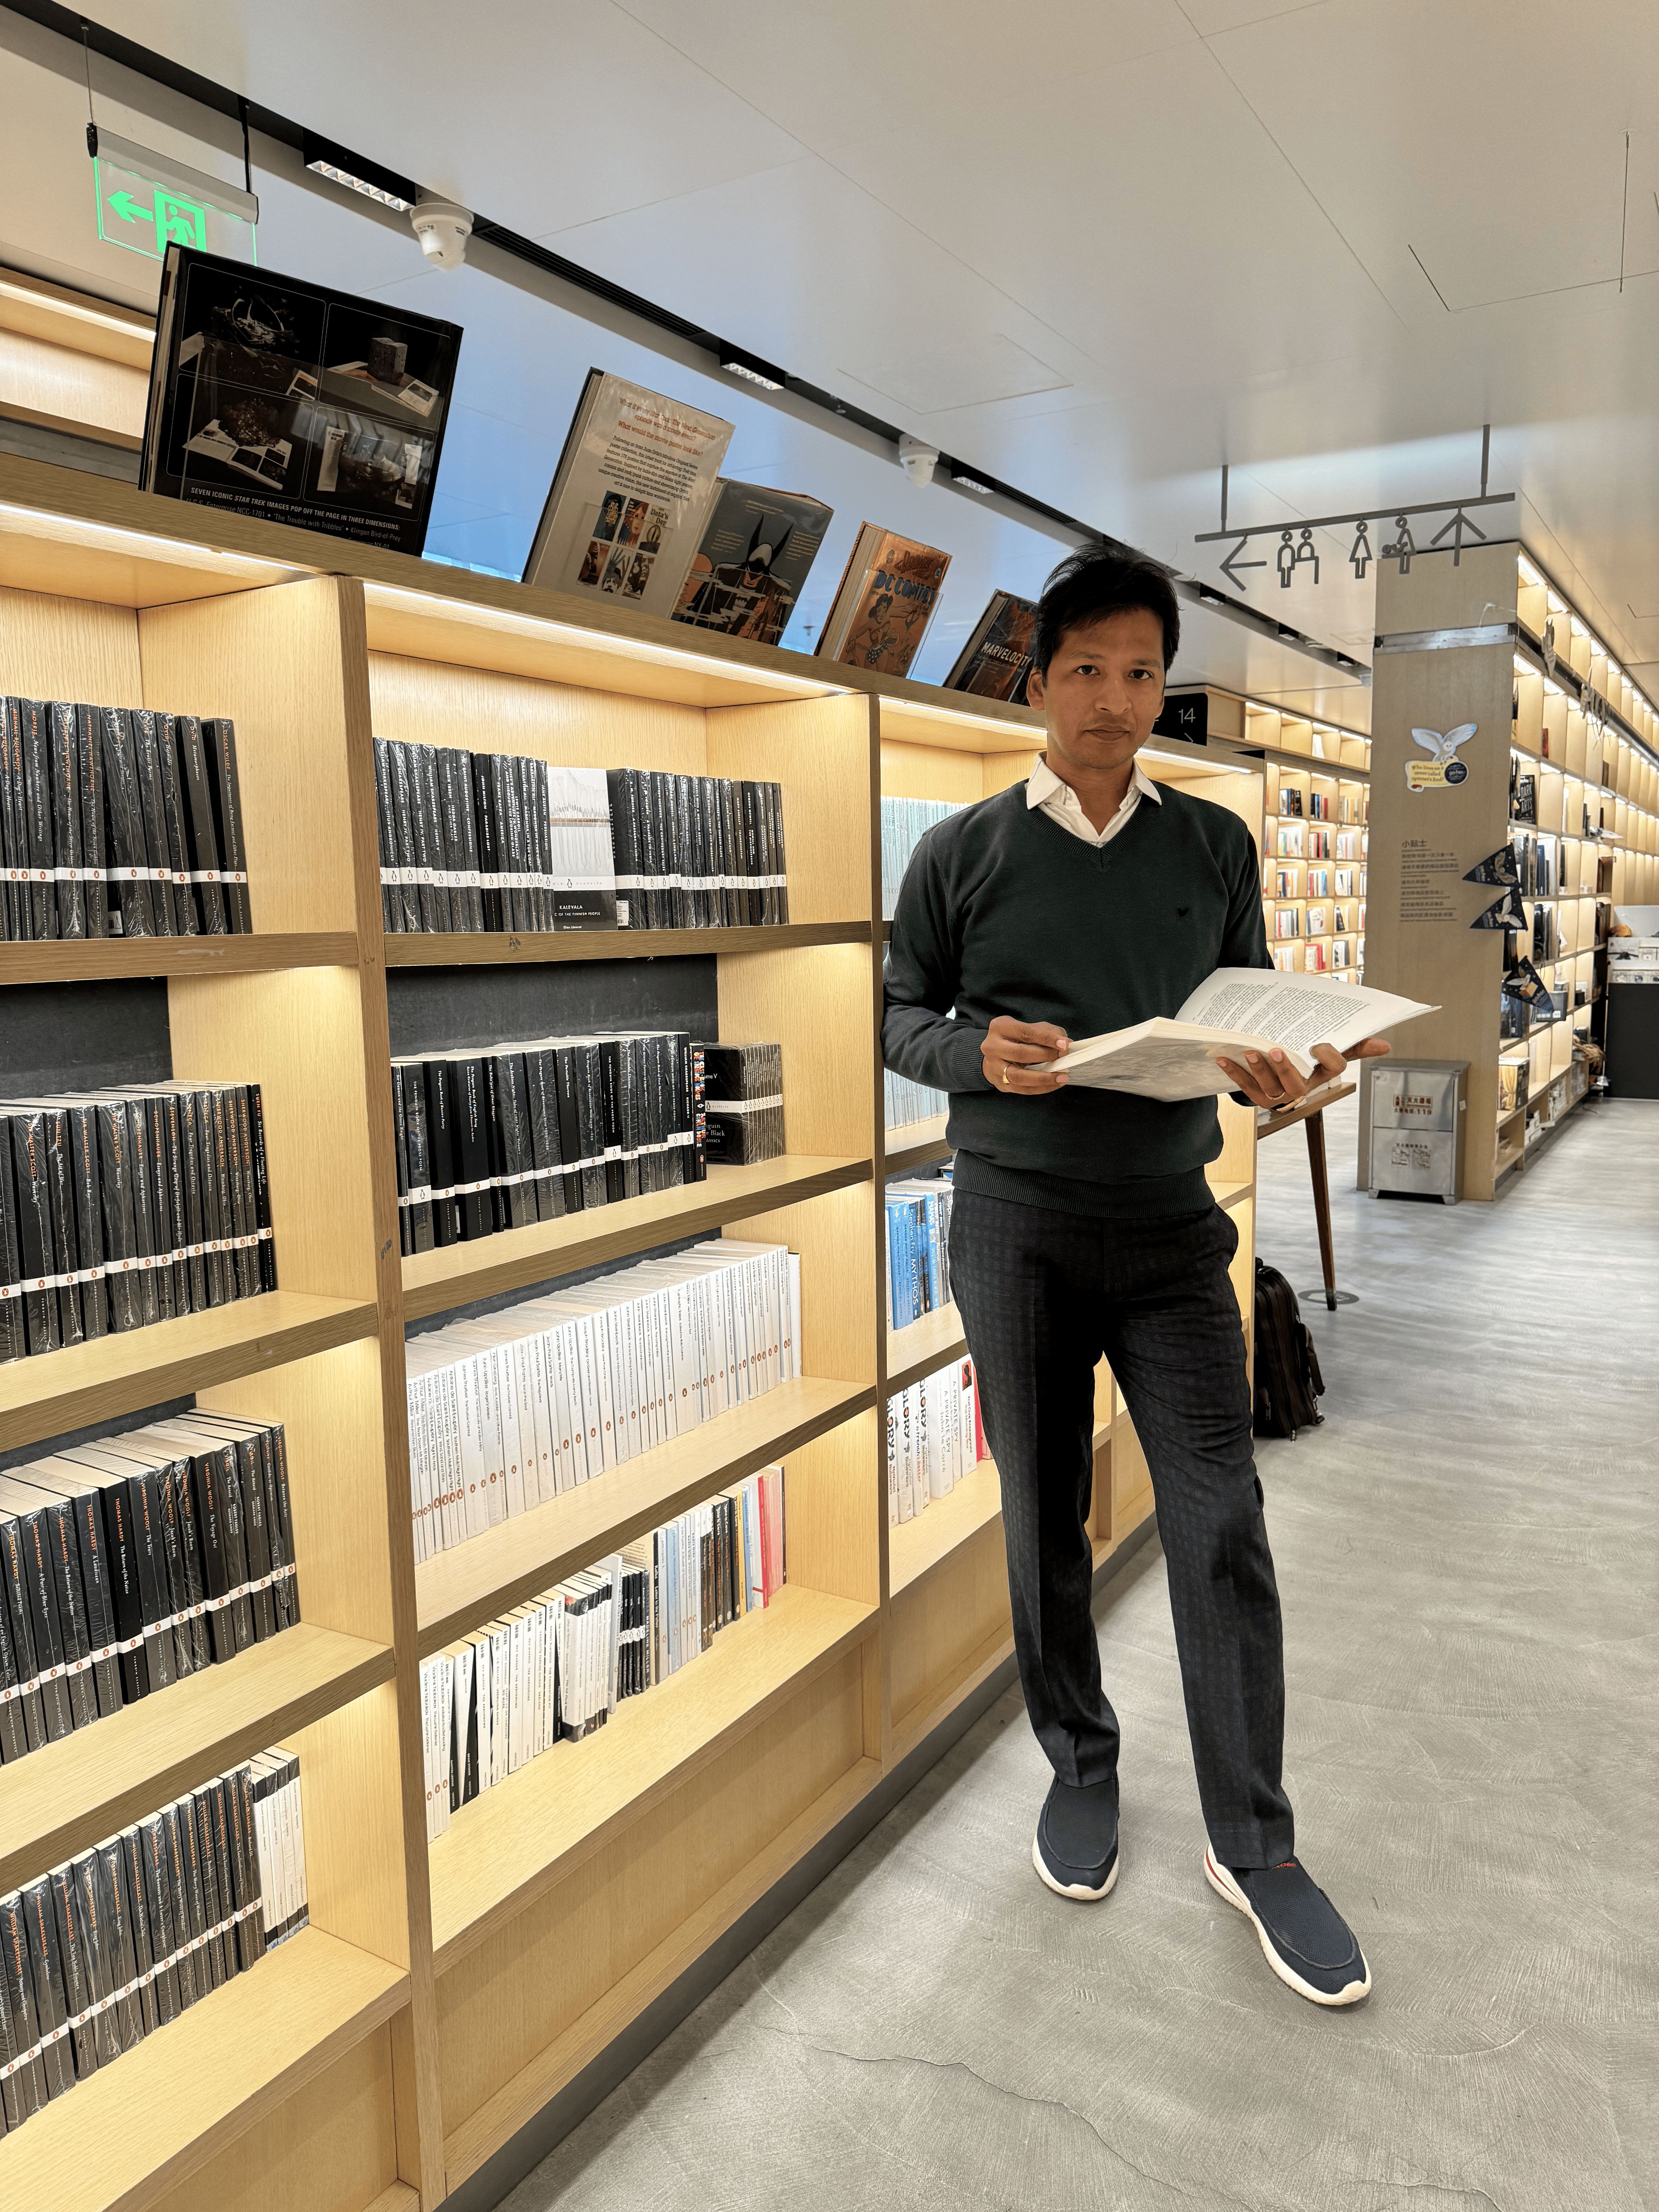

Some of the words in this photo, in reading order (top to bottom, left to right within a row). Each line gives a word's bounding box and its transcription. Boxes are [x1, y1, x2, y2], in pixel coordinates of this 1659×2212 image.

[618, 421, 630, 430] What
[632, 427, 646, 436] would
[654, 436, 668, 444] movie
[668, 441, 682, 450] poster
[683, 445, 692, 453] look
[191, 487, 210, 496] SEVEN
[212, 491, 233, 500] ICONIC
[267, 501, 289, 510] IMAGES
[365, 519, 400, 530] DIMENSIONS:
[651, 508, 669, 519] Data's
[237, 507, 264, 517] NCC-1701
[287, 516, 306, 525] Trouble
[350, 527, 369, 536] Klingon
[371, 531, 401, 542] Bird-of-Prey
[656, 518, 666, 526] Day
[874, 570, 895, 592] DC
[894, 577, 936, 605] COMICS
[981, 642, 1032, 667] MARVELOCITY
[1178, 708, 1195, 723] 14
[1520, 783, 1532, 799] DARK
[1521, 797, 1533, 814] ARTS
[1402, 840, 1427, 848] 小贴士
[694, 1052, 699, 1060] OF
[886, 1398, 895, 1448] GLORY
